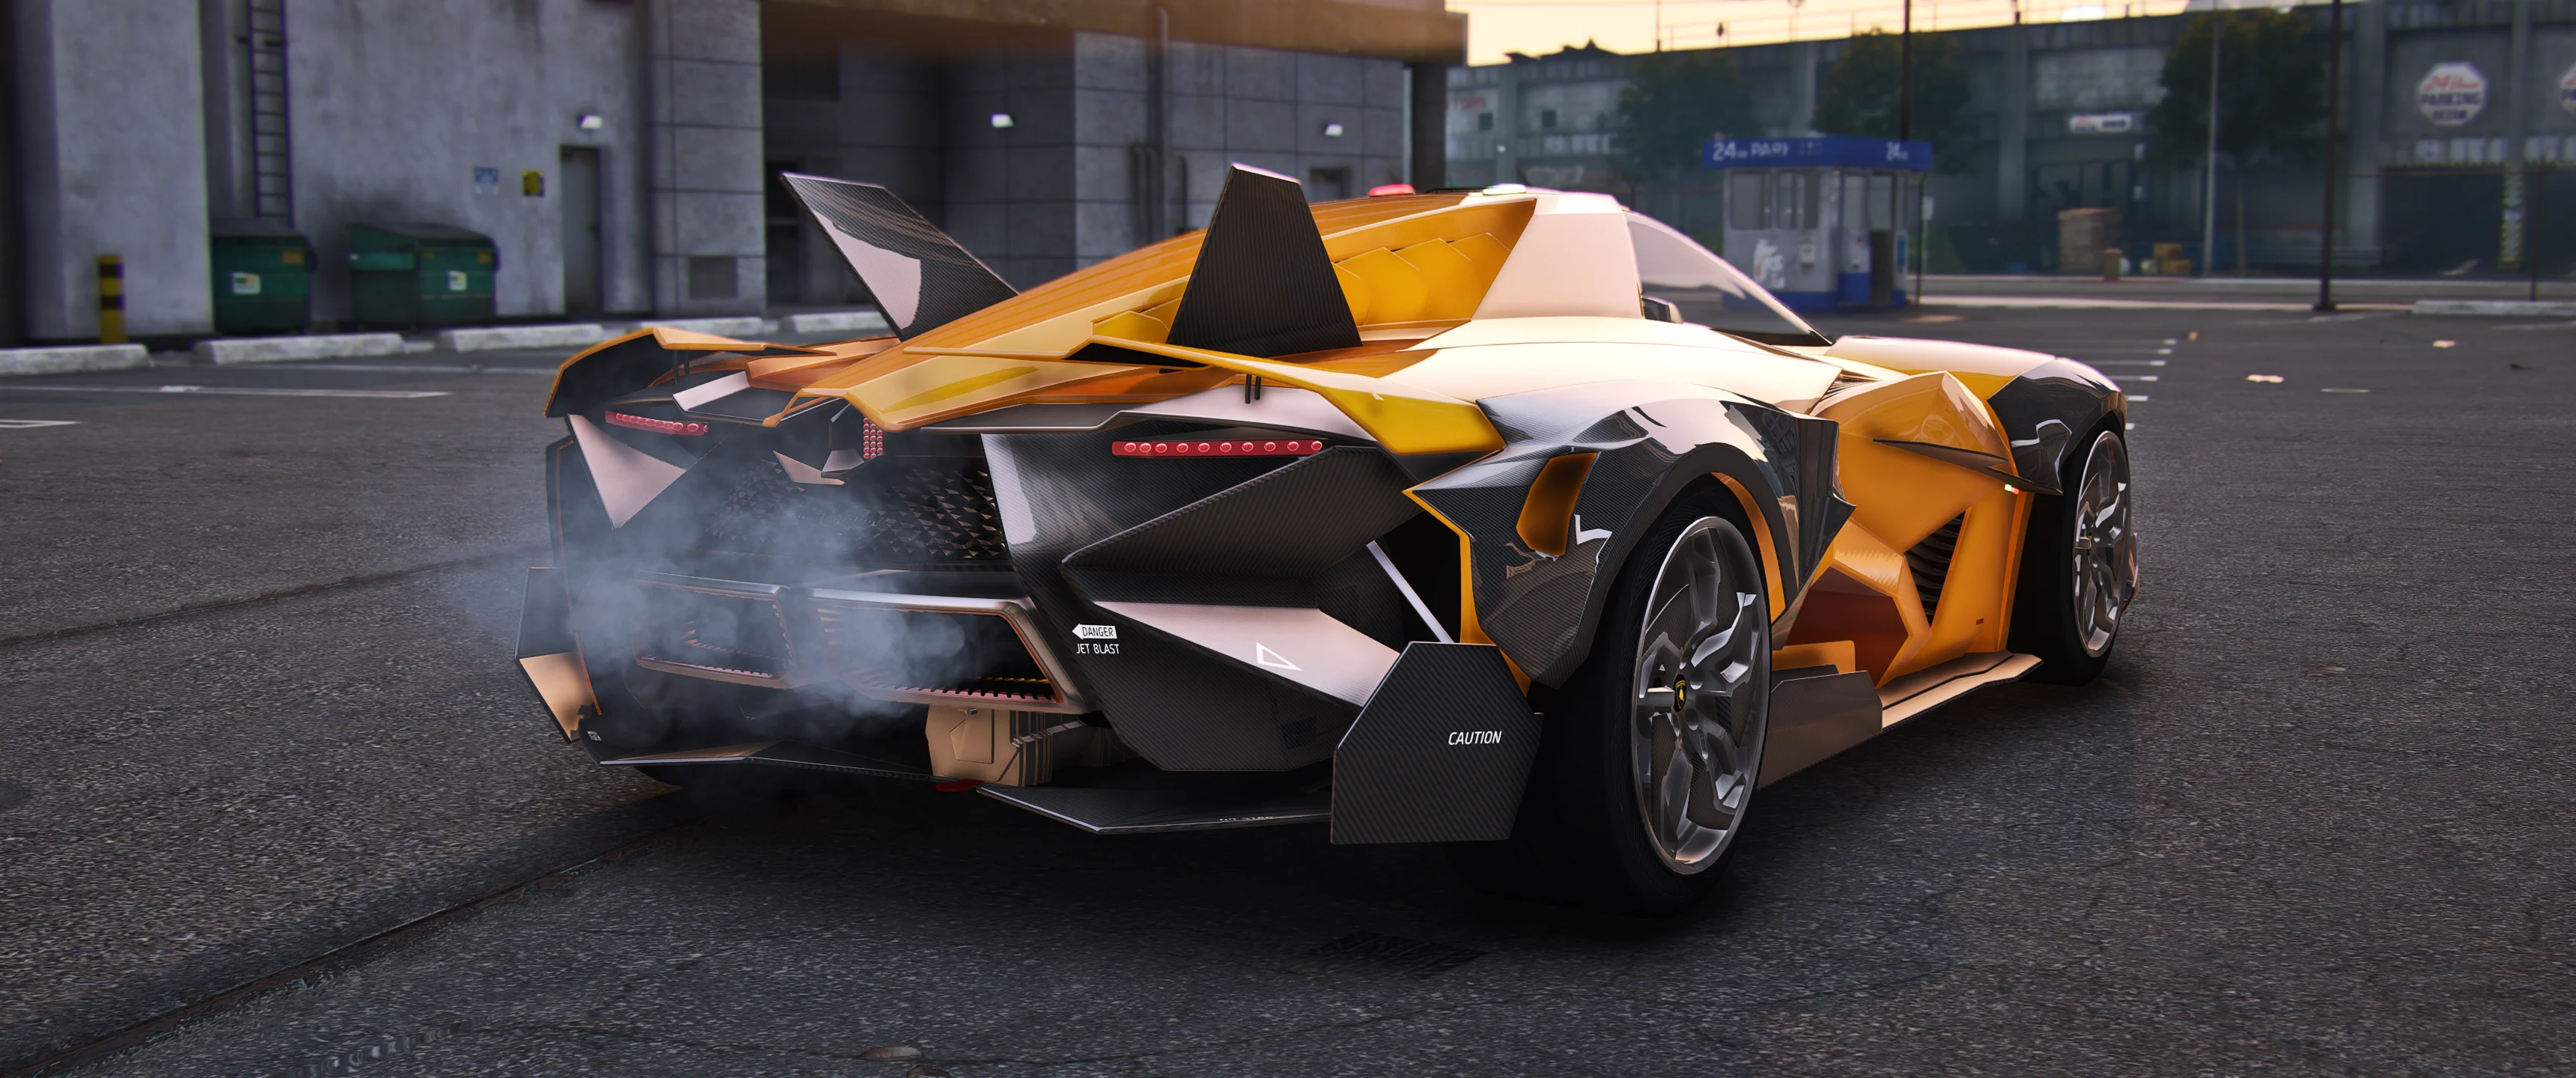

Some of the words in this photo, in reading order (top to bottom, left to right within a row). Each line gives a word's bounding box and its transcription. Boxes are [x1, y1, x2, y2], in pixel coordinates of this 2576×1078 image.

[1081, 627, 1114, 637] DANGER
[1075, 643, 1090, 654] JET
[1093, 643, 1120, 654] BLAST
[1448, 730, 1502, 746] CAUTION
